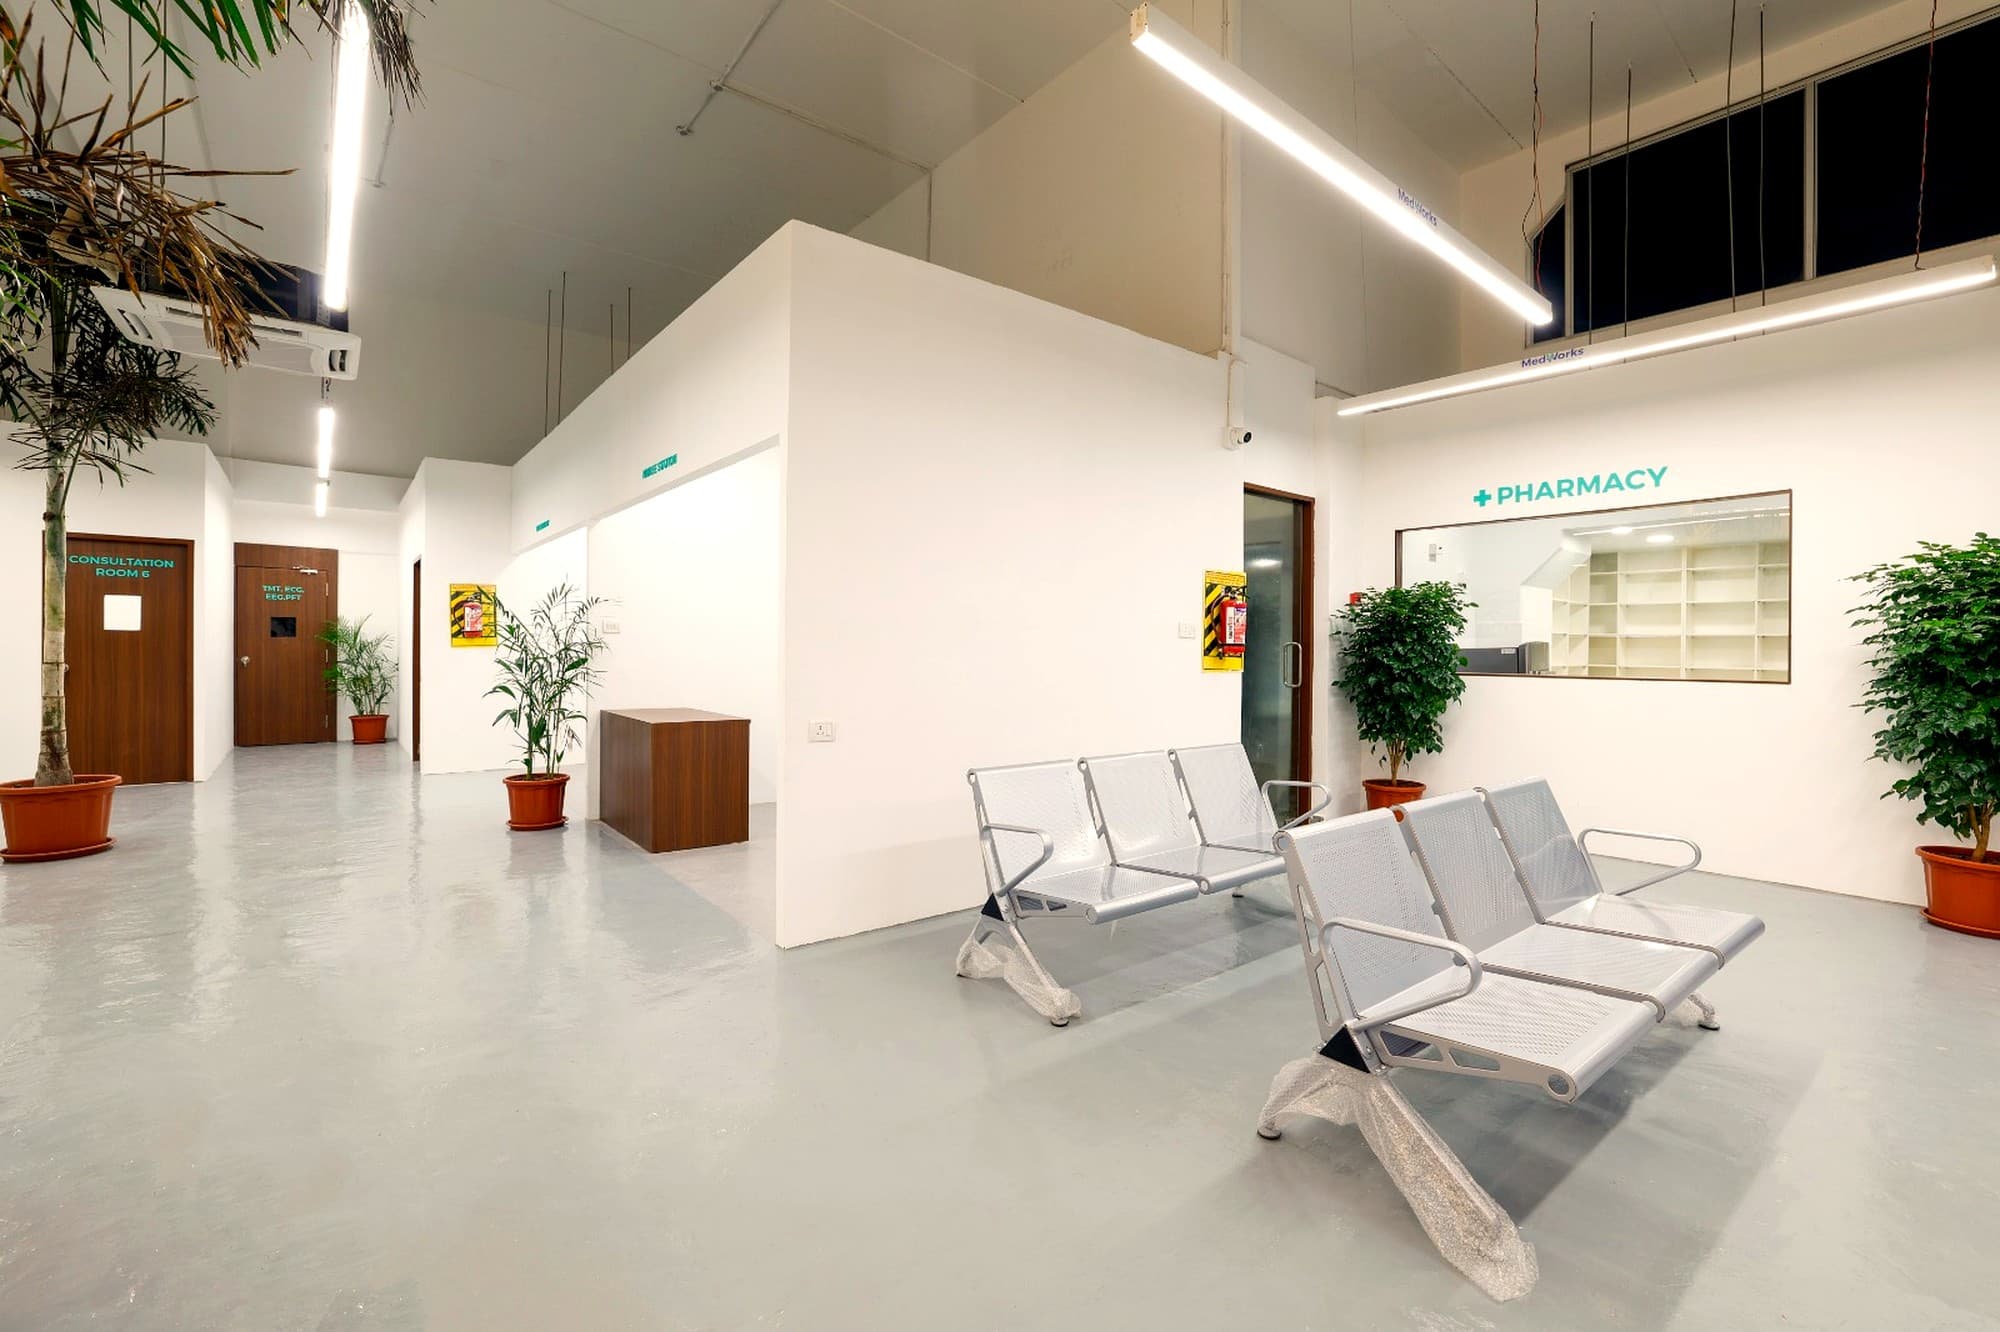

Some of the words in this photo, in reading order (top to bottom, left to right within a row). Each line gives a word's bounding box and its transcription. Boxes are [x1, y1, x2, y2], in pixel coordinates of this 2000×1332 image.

[1521, 347, 1584, 368] MedWorks
[1497, 465, 1668, 505] PHARMACY
[69, 555, 174, 568] CONSULTATION
[96, 568, 138, 577] ROOM
[142, 570, 150, 578] 6
